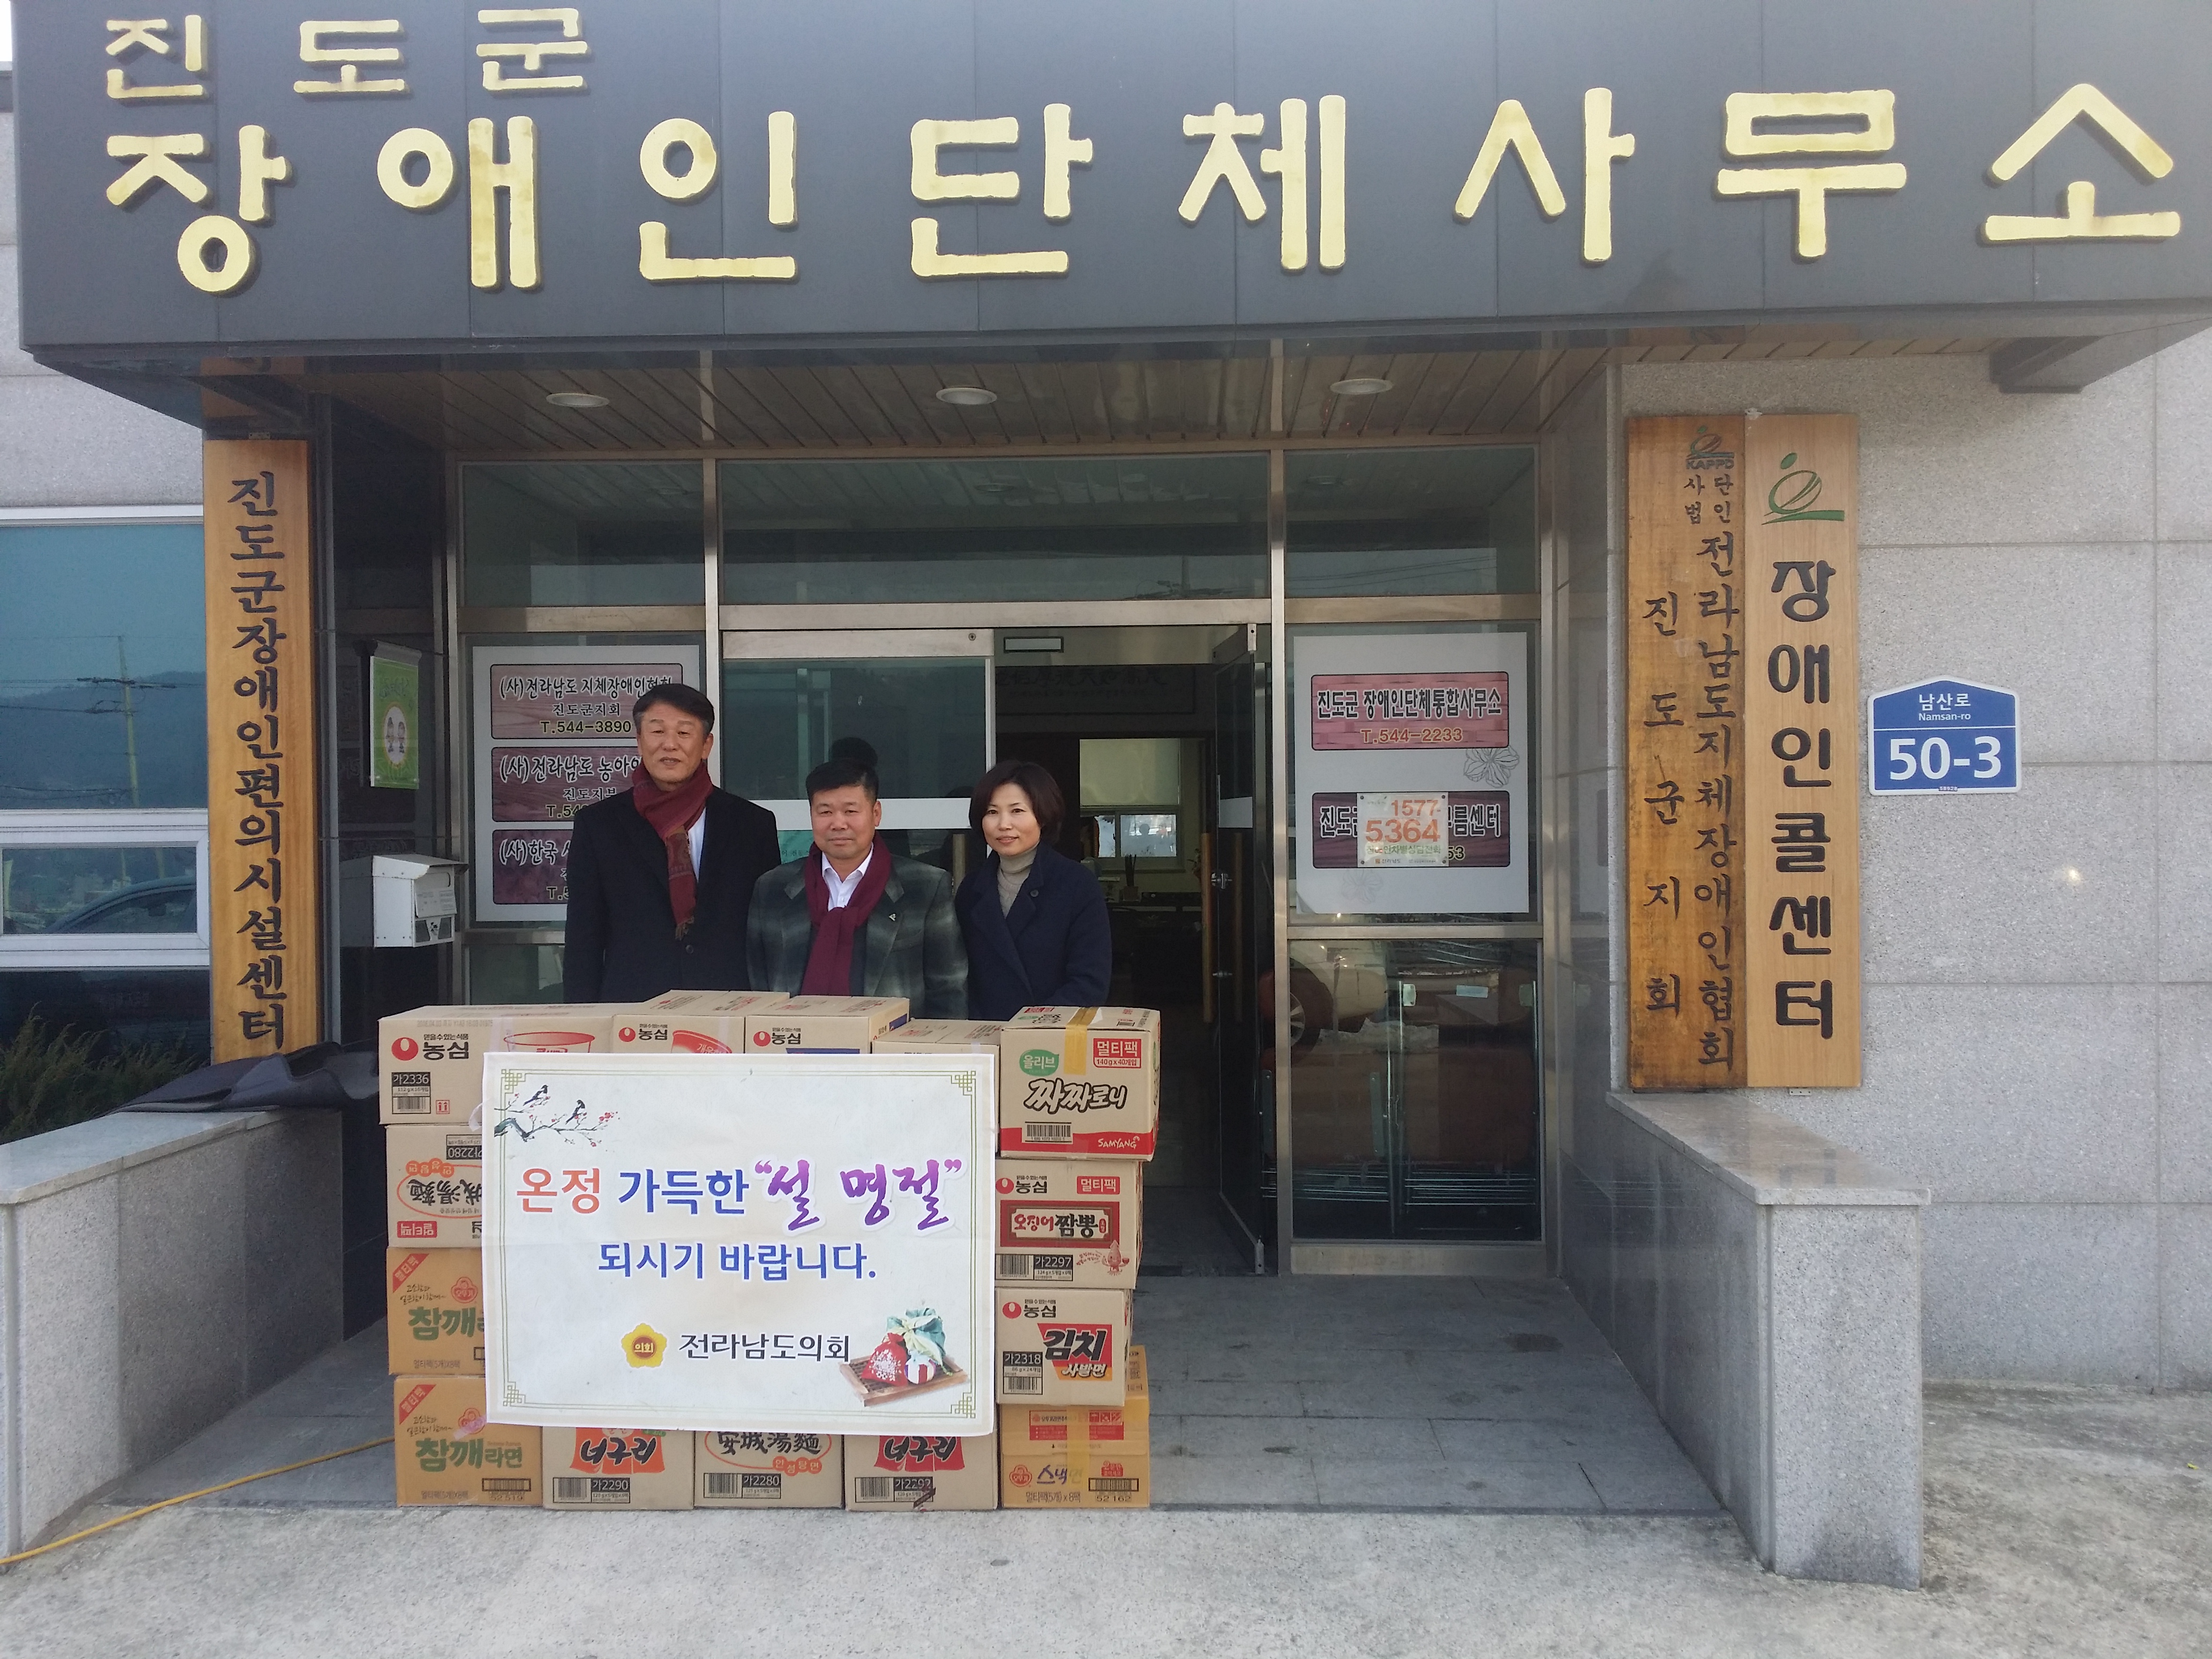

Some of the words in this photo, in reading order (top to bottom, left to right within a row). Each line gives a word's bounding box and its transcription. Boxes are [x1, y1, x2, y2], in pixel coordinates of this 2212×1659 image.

[106, 8, 589, 99] 진도군
[106, 83, 2181, 292] 장애인단체사무소
[1686, 459, 1735, 470] KAPPD
[552, 703, 622, 717] 진도군지회
[1317, 689, 1359, 719] 진도군
[1363, 687, 1501, 720] 장애인단체통합사무소
[1918, 693, 1971, 711] 남산로
[1918, 713, 1971, 721] Namsan-ro
[540, 720, 632, 735] T.544-3890
[1360, 727, 1463, 744] T.544-2233
[227, 471, 287, 1049] 진도군장애인편의시설센터
[1890, 736, 2001, 780] 50-3
[1642, 591, 1685, 1018] 진도군지회
[1694, 531, 1740, 1072] 전라남도지체장애인협회
[1768, 560, 1836, 1040] 장애인콜센터
[1448, 804, 1501, 838] 름센터
[1365, 819, 1441, 843] 5364
[638, 1028, 668, 1041] 농심
[771, 1033, 801, 1045] 농심
[422, 1041, 469, 1060] 농심
[1097, 1041, 1138, 1057] 멀티팩
[1023, 1055, 1055, 1070] 올리브
[393, 1074, 429, 1085] 가2336
[1023, 1078, 1128, 1114] 짜짜로니
[1097, 1137, 1138, 1149] SAMYANG
[516, 1168, 601, 1214] 온정
[618, 1169, 750, 1215] 가득한
[1015, 1180, 1047, 1194] 농심
[1080, 1178, 1116, 1192] 멀티팩
[400, 1223, 434, 1236] 멀티팩
[599, 1243, 705, 1280] 되시기
[720, 1243, 877, 1281] 바랍니다.
[1035, 1257, 1072, 1268] 가2297
[1023, 1305, 1056, 1318] 농심
[634, 1342, 654, 1354] 의회
[678, 1333, 850, 1362] 전라남도의회
[1043, 1328, 1108, 1362] 김치
[1005, 1353, 1041, 1365] 가2318
[1062, 1363, 1107, 1379] 사발면
[580, 1436, 658, 1466] 너구리
[883, 1436, 957, 1462] 너구리
[775, 1459, 820, 1474] 안성탕면
[593, 1479, 629, 1491] 가2290
[744, 1476, 779, 1486] 가2280
